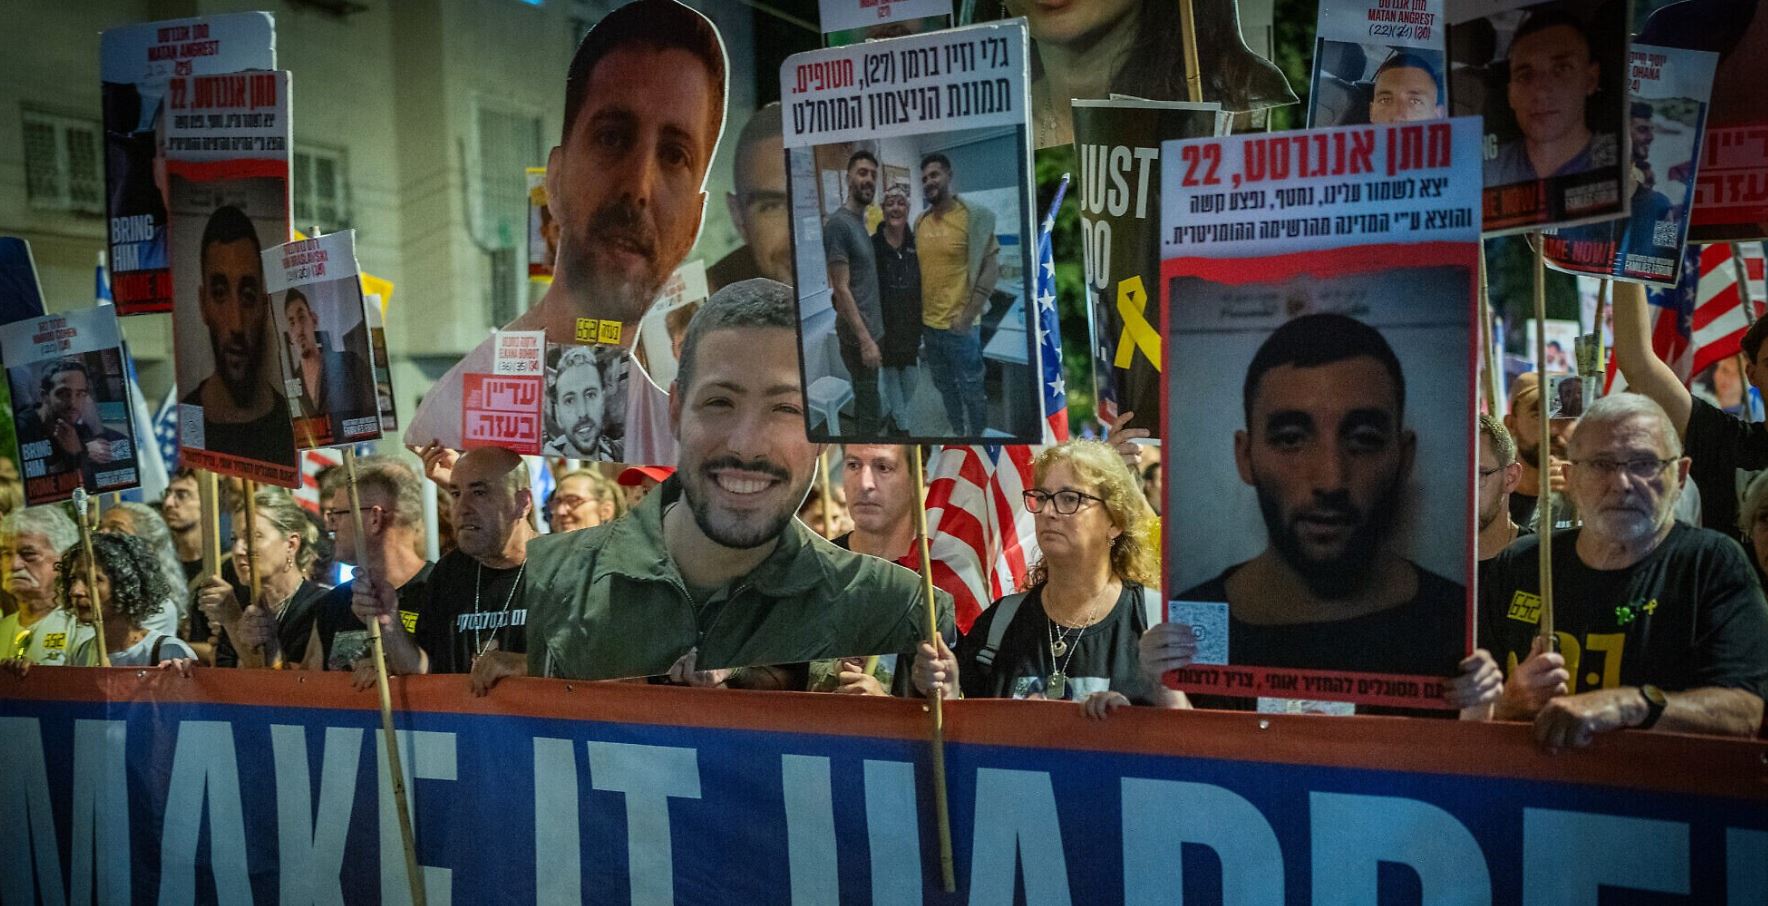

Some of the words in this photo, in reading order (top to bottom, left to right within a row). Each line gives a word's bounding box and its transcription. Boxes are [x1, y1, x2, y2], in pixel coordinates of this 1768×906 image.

[1368, 8, 1396, 22] MATAN
[1397, 11, 1435, 26] ANGREST
[900, 47, 940, 84] ברמן
[944, 42, 976, 74] וזיו
[979, 37, 1009, 69] גלי
[792, 59, 854, 94] חטופים.
[858, 51, 897, 91] (27),
[1632, 65, 1660, 80] OHANA
[170, 78, 187, 109] 22
[947, 78, 1012, 118] תמונת
[793, 96, 863, 135] המוחלט
[867, 86, 941, 130] הניצחון
[1232, 129, 1375, 192] אנגרסט,
[1386, 123, 1452, 176] מתן
[1181, 143, 1222, 187] 22
[1228, 190, 1266, 210] נפצע
[1269, 186, 1315, 210] נחטף,
[1319, 182, 1361, 206] עלינו,
[1366, 177, 1416, 202] לשמור
[1419, 177, 1449, 198] יצא
[1190, 193, 1224, 215] קשה
[112, 213, 154, 244] BRING
[1260, 217, 1332, 239] מהרשימה
[1335, 213, 1390, 235] המדינה
[1425, 207, 1473, 228] והוצא
[1165, 221, 1255, 246] ההומניטרית.
[112, 243, 140, 273] HIM
[1081, 218, 1112, 290] DO
[1572, 238, 1616, 273] NOW!
[577, 319, 598, 341] 652
[486, 382, 536, 408] עדיין
[472, 415, 536, 439] בעזה.
[22, 440, 53, 461] BRING
[25, 459, 47, 478] HIM
[1174, 668, 1219, 687] לרצות
[1222, 671, 1254, 689] צריך
[1301, 675, 1352, 695] להחזיר
[1358, 678, 1419, 698] מסוגלים
[0, 715, 458, 906] MAKE
[532, 736, 703, 906] IT
